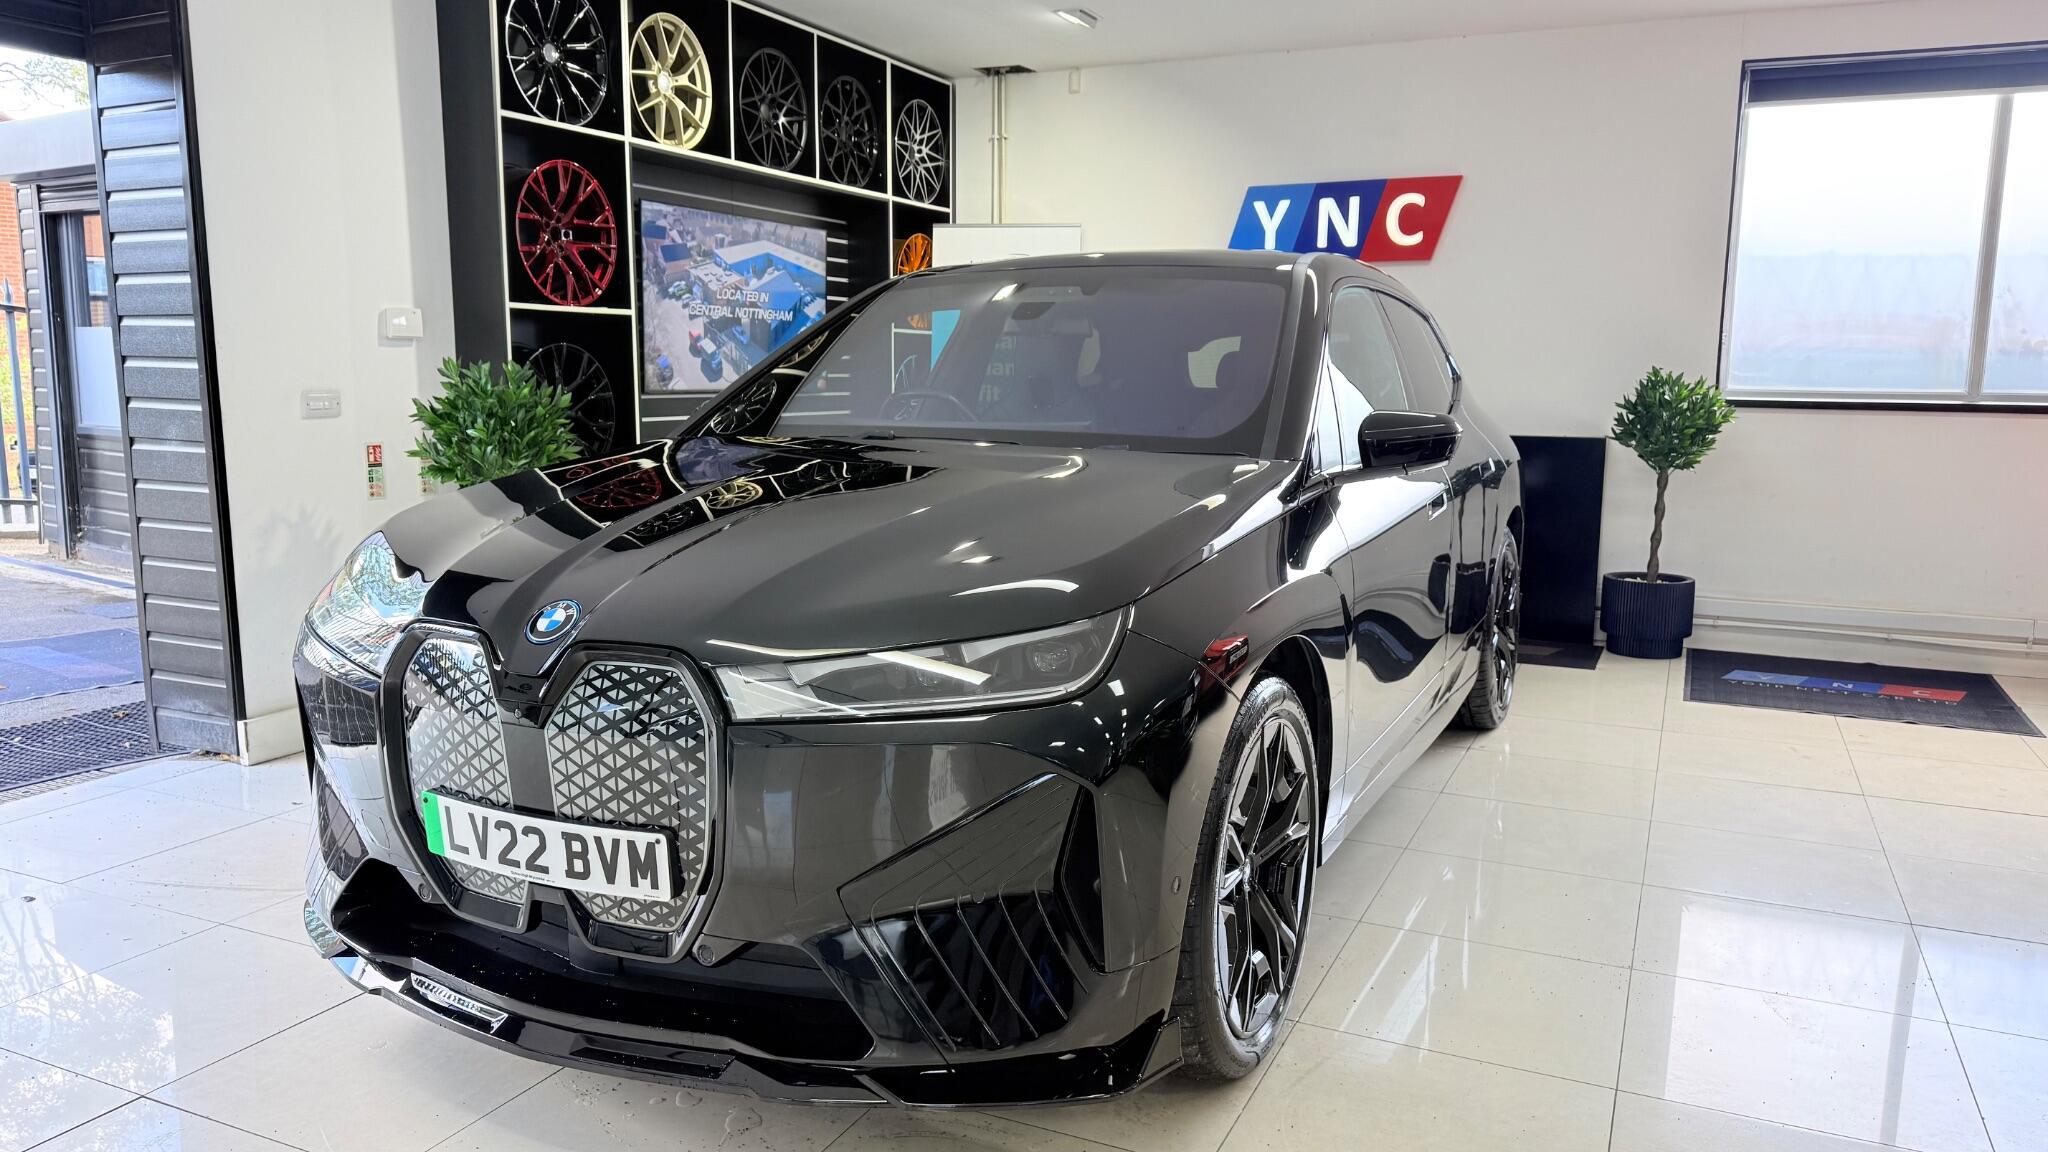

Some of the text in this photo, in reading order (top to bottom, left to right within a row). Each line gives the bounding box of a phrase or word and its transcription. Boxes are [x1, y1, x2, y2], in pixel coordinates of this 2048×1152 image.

[1253, 192, 1425, 250] YNC
[716, 288, 769, 302] LOCATED IN
[688, 303, 793, 321] CENTRAL NOTTINGHAM
[1727, 680, 1784, 688] YOUR
[1796, 686, 1851, 695] NEXT
[444, 805, 660, 890] LV22 BVM
